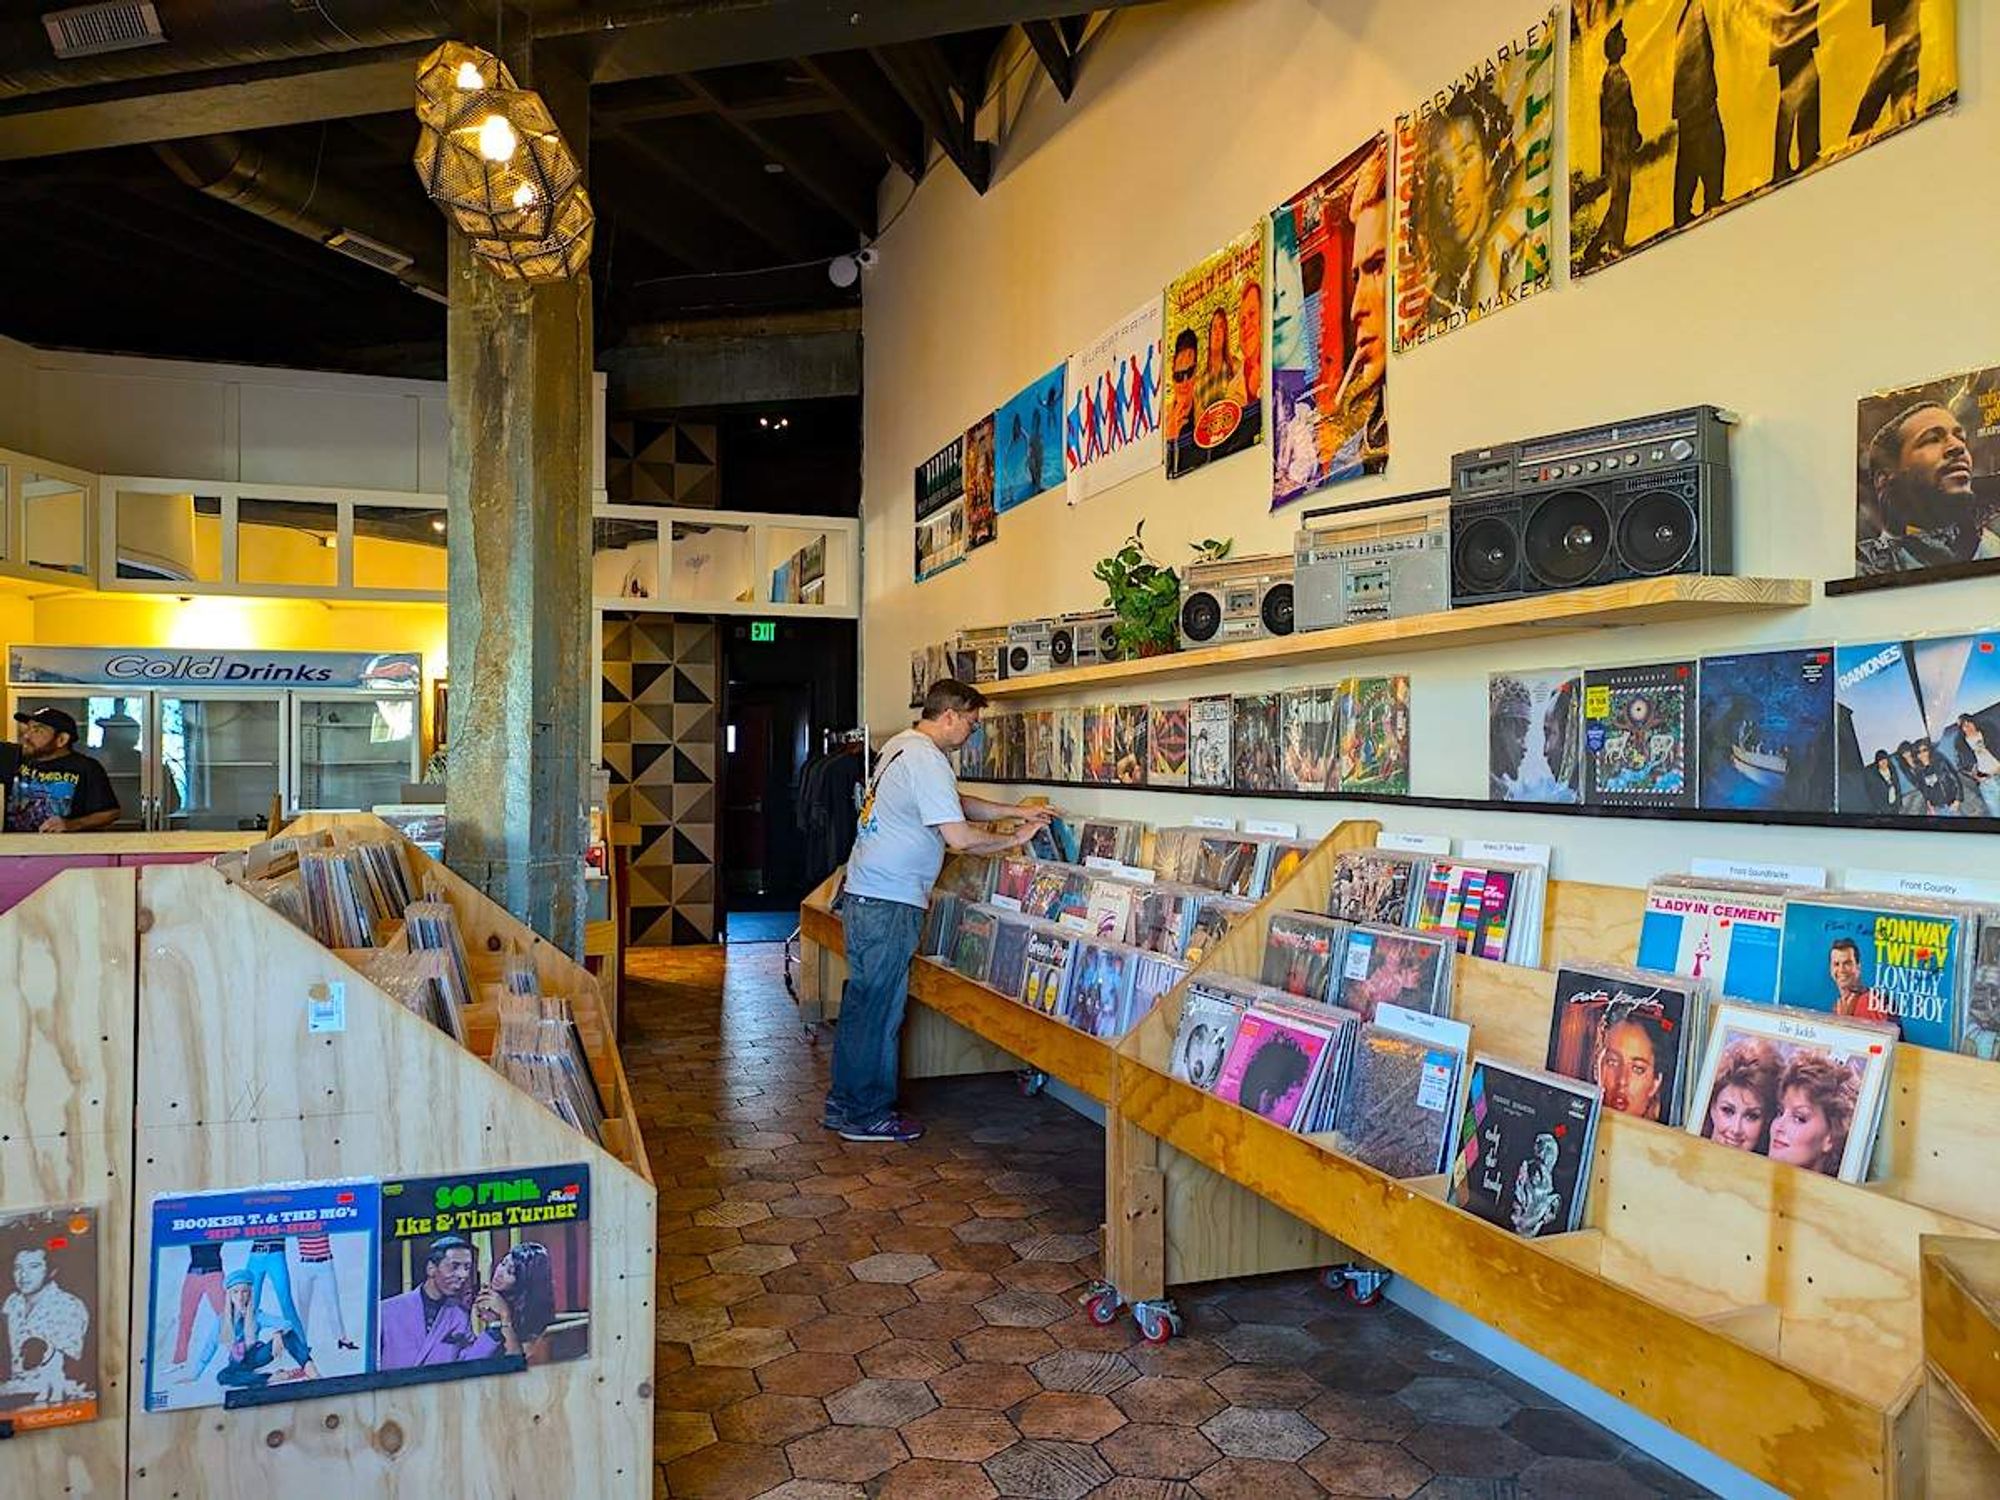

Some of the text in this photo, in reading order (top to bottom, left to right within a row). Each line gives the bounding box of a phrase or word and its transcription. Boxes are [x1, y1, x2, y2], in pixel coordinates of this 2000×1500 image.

[1400, 309, 1472, 352] MELODY
[752, 622, 776, 641] EXIT
[105, 654, 332, 682] Cold Drinks
[1838, 645, 1901, 690] RAMONES
[1900, 880, 1957, 895] Front Country
[1694, 903, 1708, 915] IN
[1875, 916, 1950, 947] CONWAY
[1875, 940, 1948, 970] TWITTY
[1875, 964, 1944, 998] LONELY
[1868, 988, 1947, 1024] BLUE BOY
[435, 1185, 475, 1209] SO
[478, 1178, 541, 1205] FINE
[172, 1206, 358, 1231] BOOKER T. & THE MG's
[395, 1202, 577, 1236] Ike & Tina Turner
